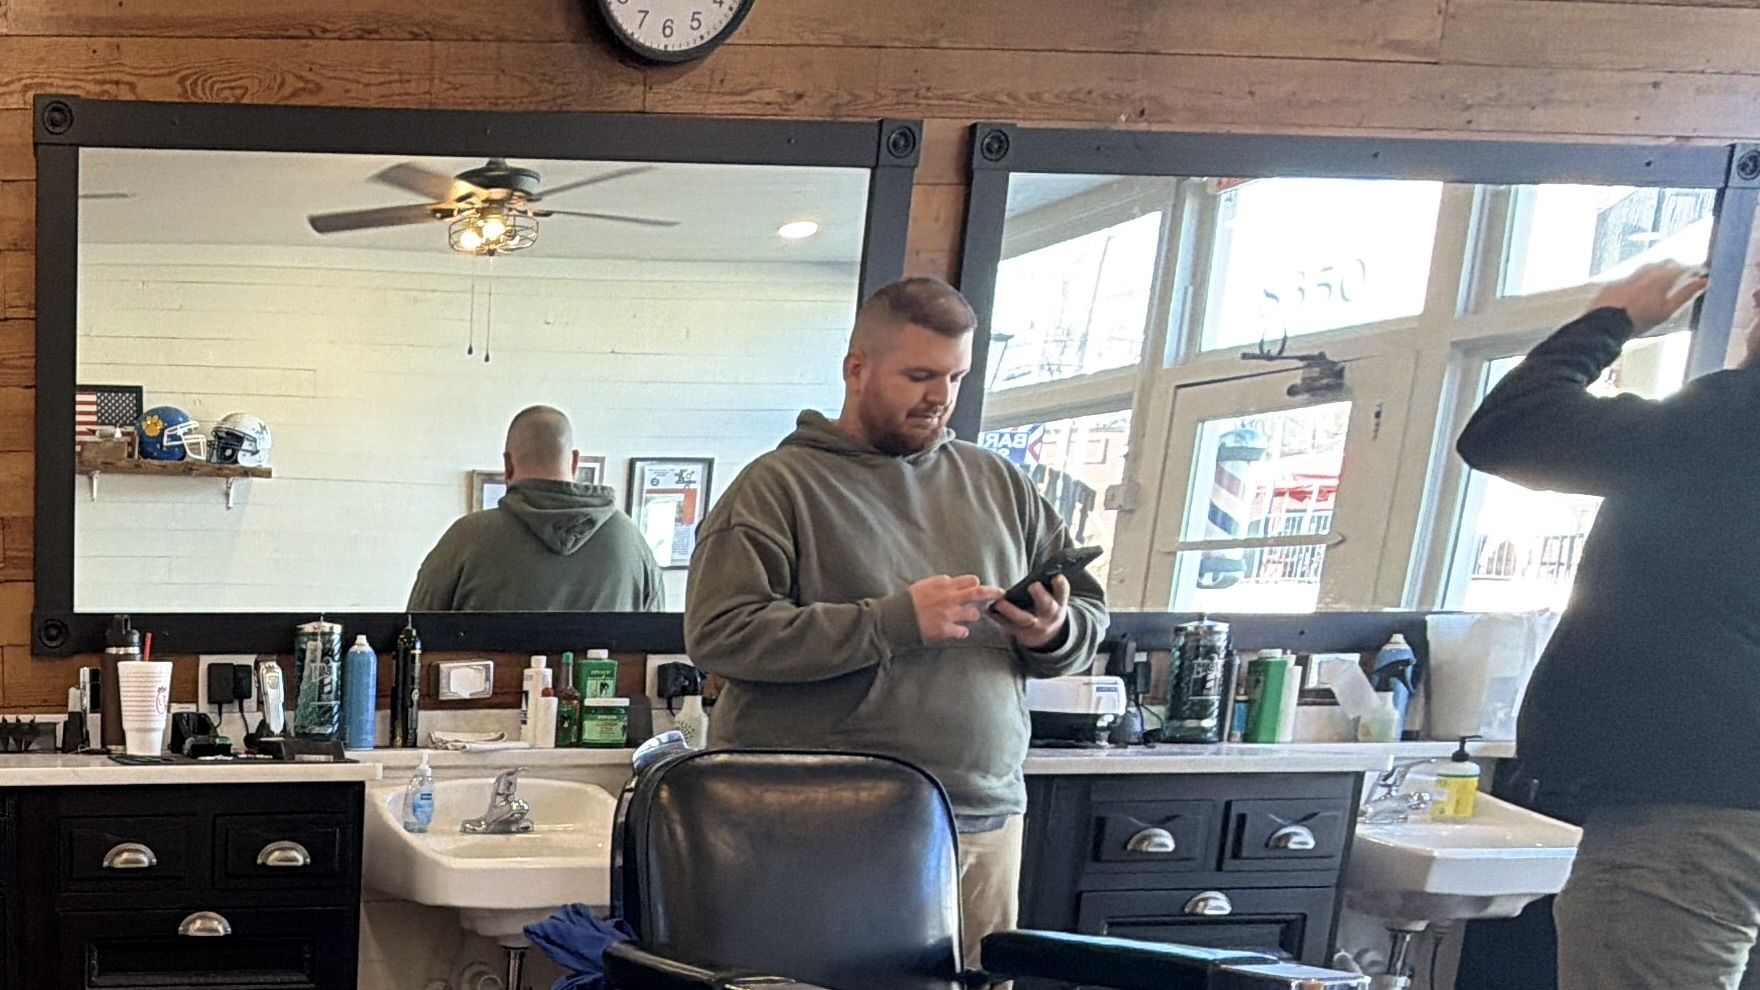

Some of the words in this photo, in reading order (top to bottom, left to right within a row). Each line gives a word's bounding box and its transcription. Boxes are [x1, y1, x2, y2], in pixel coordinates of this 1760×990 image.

[638, 10, 649, 29] 7
[661, 18, 674, 39] 6
[690, 11, 702, 31] 5
